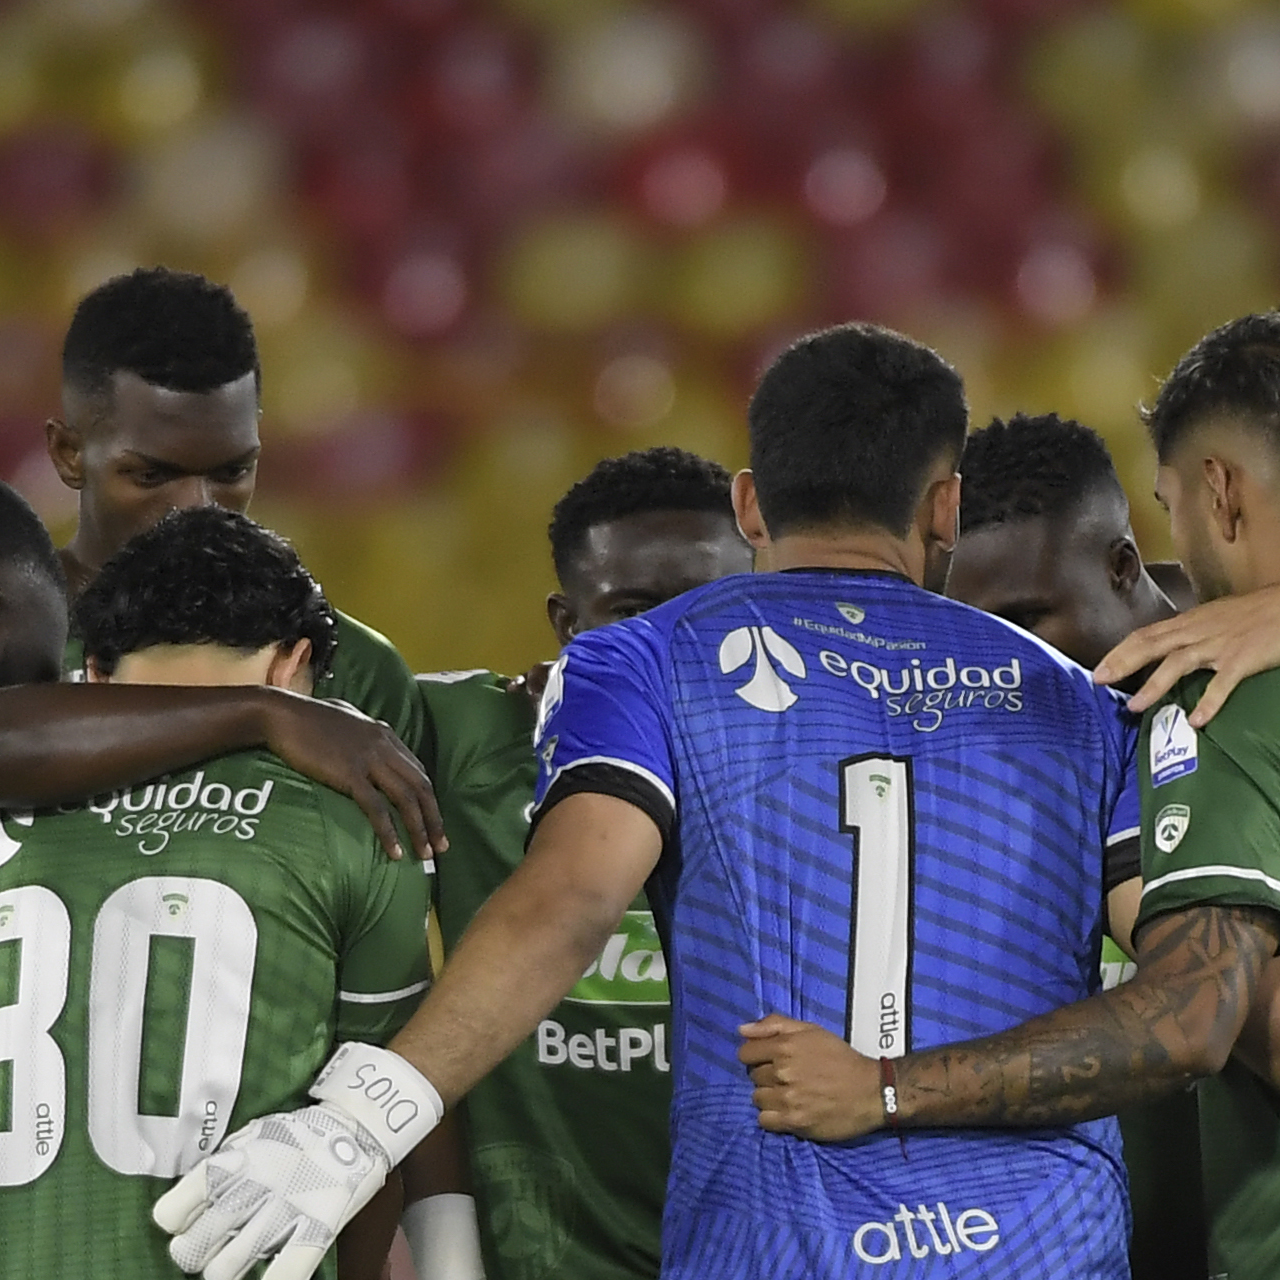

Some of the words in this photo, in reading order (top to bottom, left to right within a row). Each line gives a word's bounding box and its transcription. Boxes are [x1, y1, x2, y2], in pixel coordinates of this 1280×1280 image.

[819, 650, 1022, 699] equidad
[885, 688, 1023, 732] seguros
[59, 771, 274, 824] quidad
[115, 810, 260, 855] seguros
[841, 754, 912, 1060] 1
[878, 992, 900, 1050] attle
[347, 1063, 419, 1134] DIOS
[35, 1102, 55, 1156] attle
[853, 1202, 1000, 1264] attle
